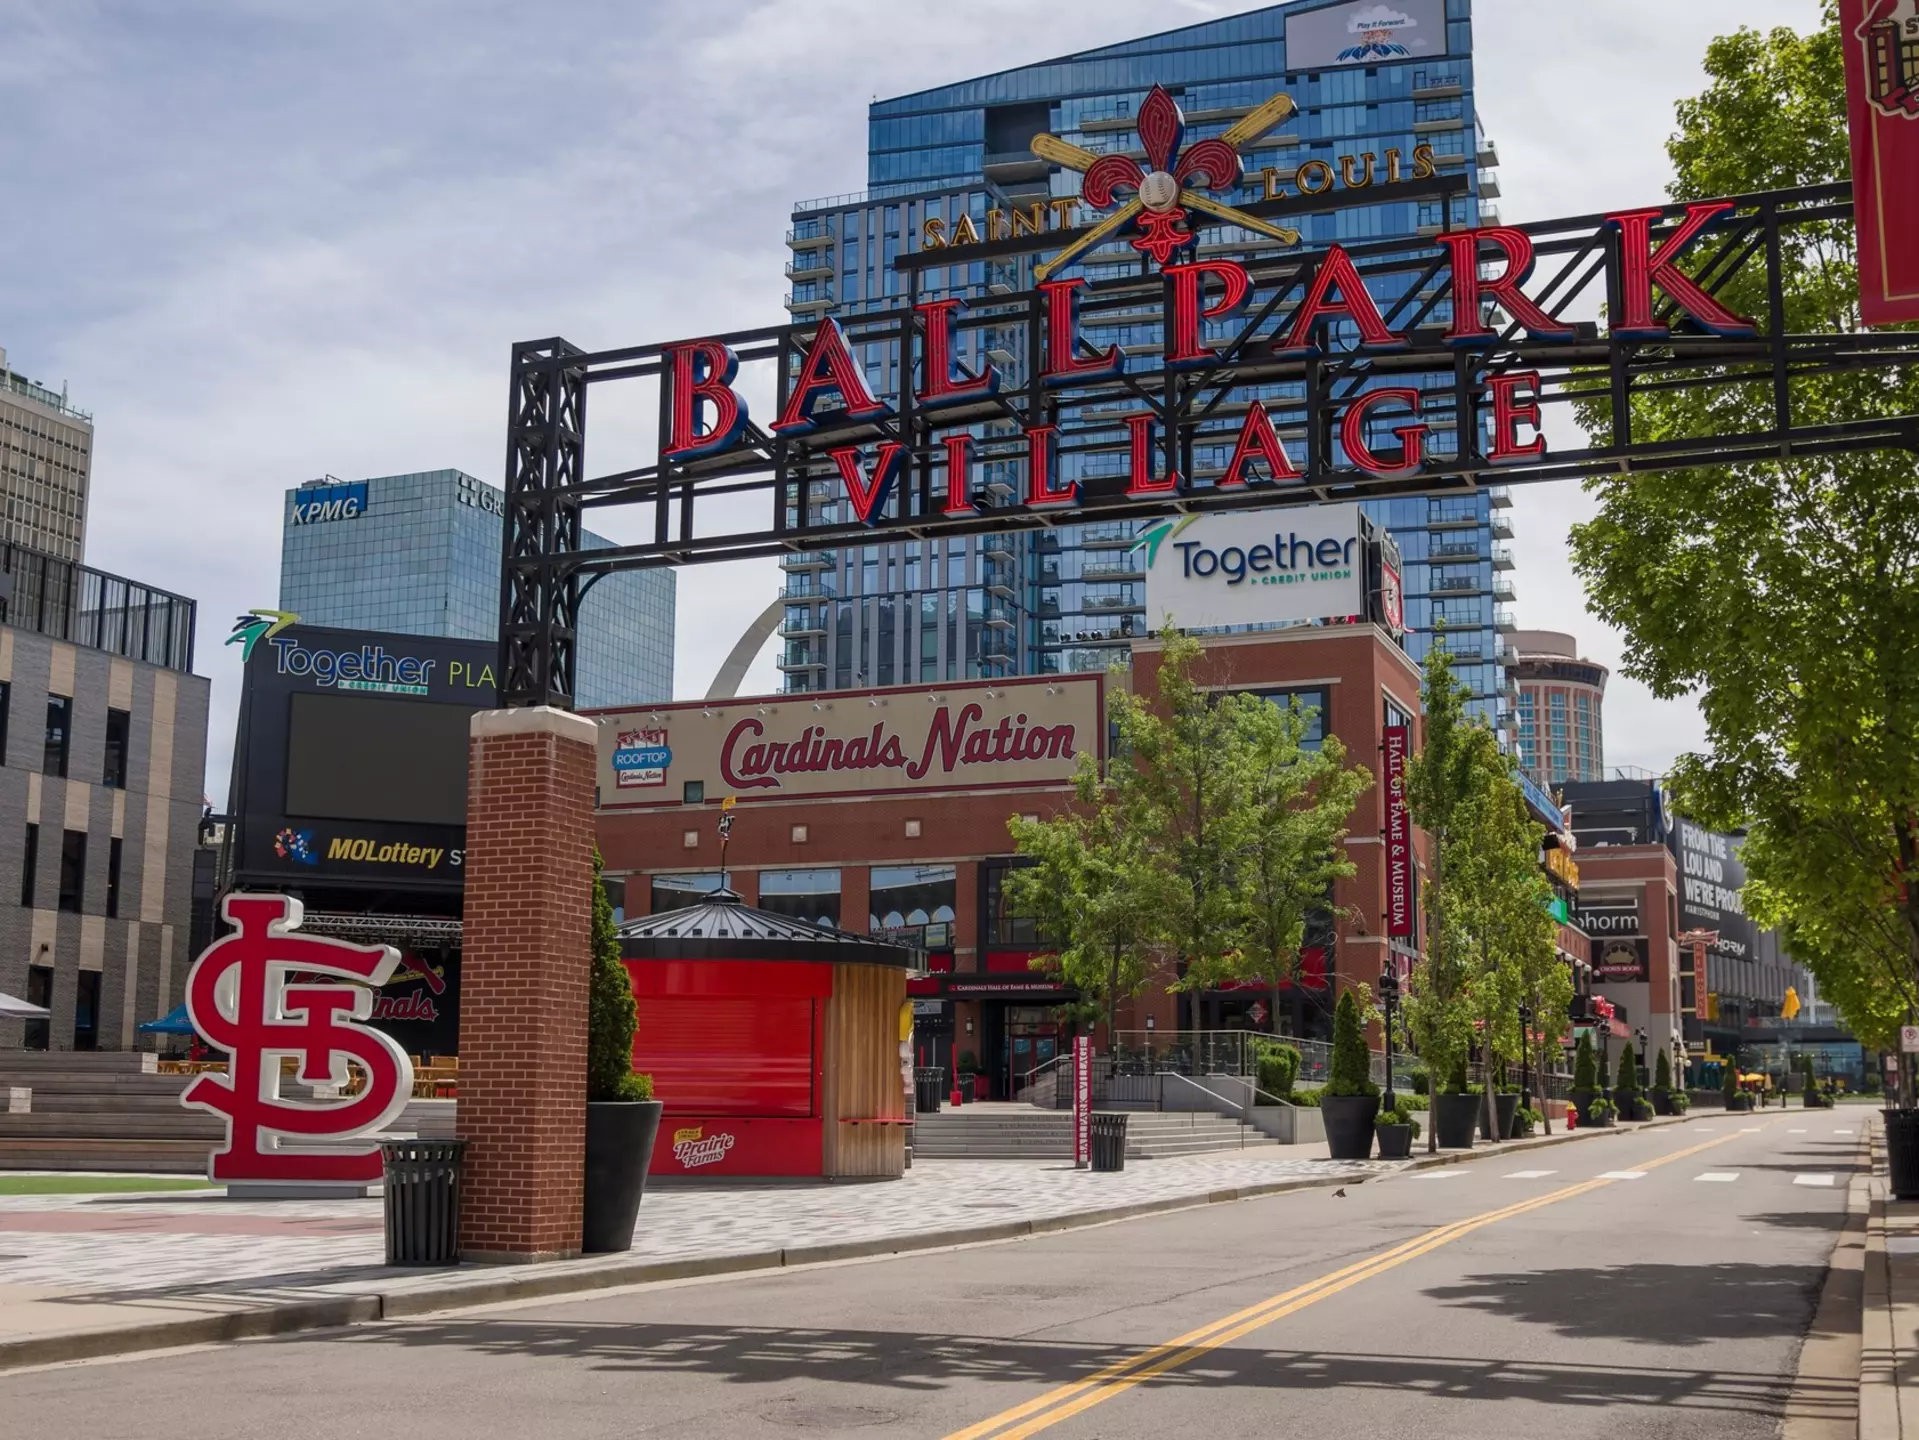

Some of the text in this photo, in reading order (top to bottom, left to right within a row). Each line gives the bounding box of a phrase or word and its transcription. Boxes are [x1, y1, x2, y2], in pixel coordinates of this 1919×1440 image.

[922, 144, 1437, 251] SAINT LOUIS
[662, 201, 1758, 462] BALLPARK
[827, 370, 1548, 527] VILLAGE
[291, 497, 359, 525] KPMG
[1173, 532, 1357, 585] Together
[1261, 570, 1352, 586] CREDIT UNION
[270, 638, 436, 687] Together
[348, 680, 428, 695] CREDIT UNION
[616, 751, 667, 765] ROOFTOP
[720, 702, 1077, 789] Cardinals Nation
[1388, 735, 1405, 927] HALL OF FAME & MUSEUM
[1681, 823, 1727, 860] FROM THE
[328, 838, 444, 869] MOLottery
[1683, 851, 1723, 883] LOU AND
[1684, 877, 1715, 906] WE'RE
[1080, 1042, 1088, 1156] BALLPARK VILLAGE
[673, 1132, 735, 1160] Prairie
[682, 1149, 725, 1168] Farms
